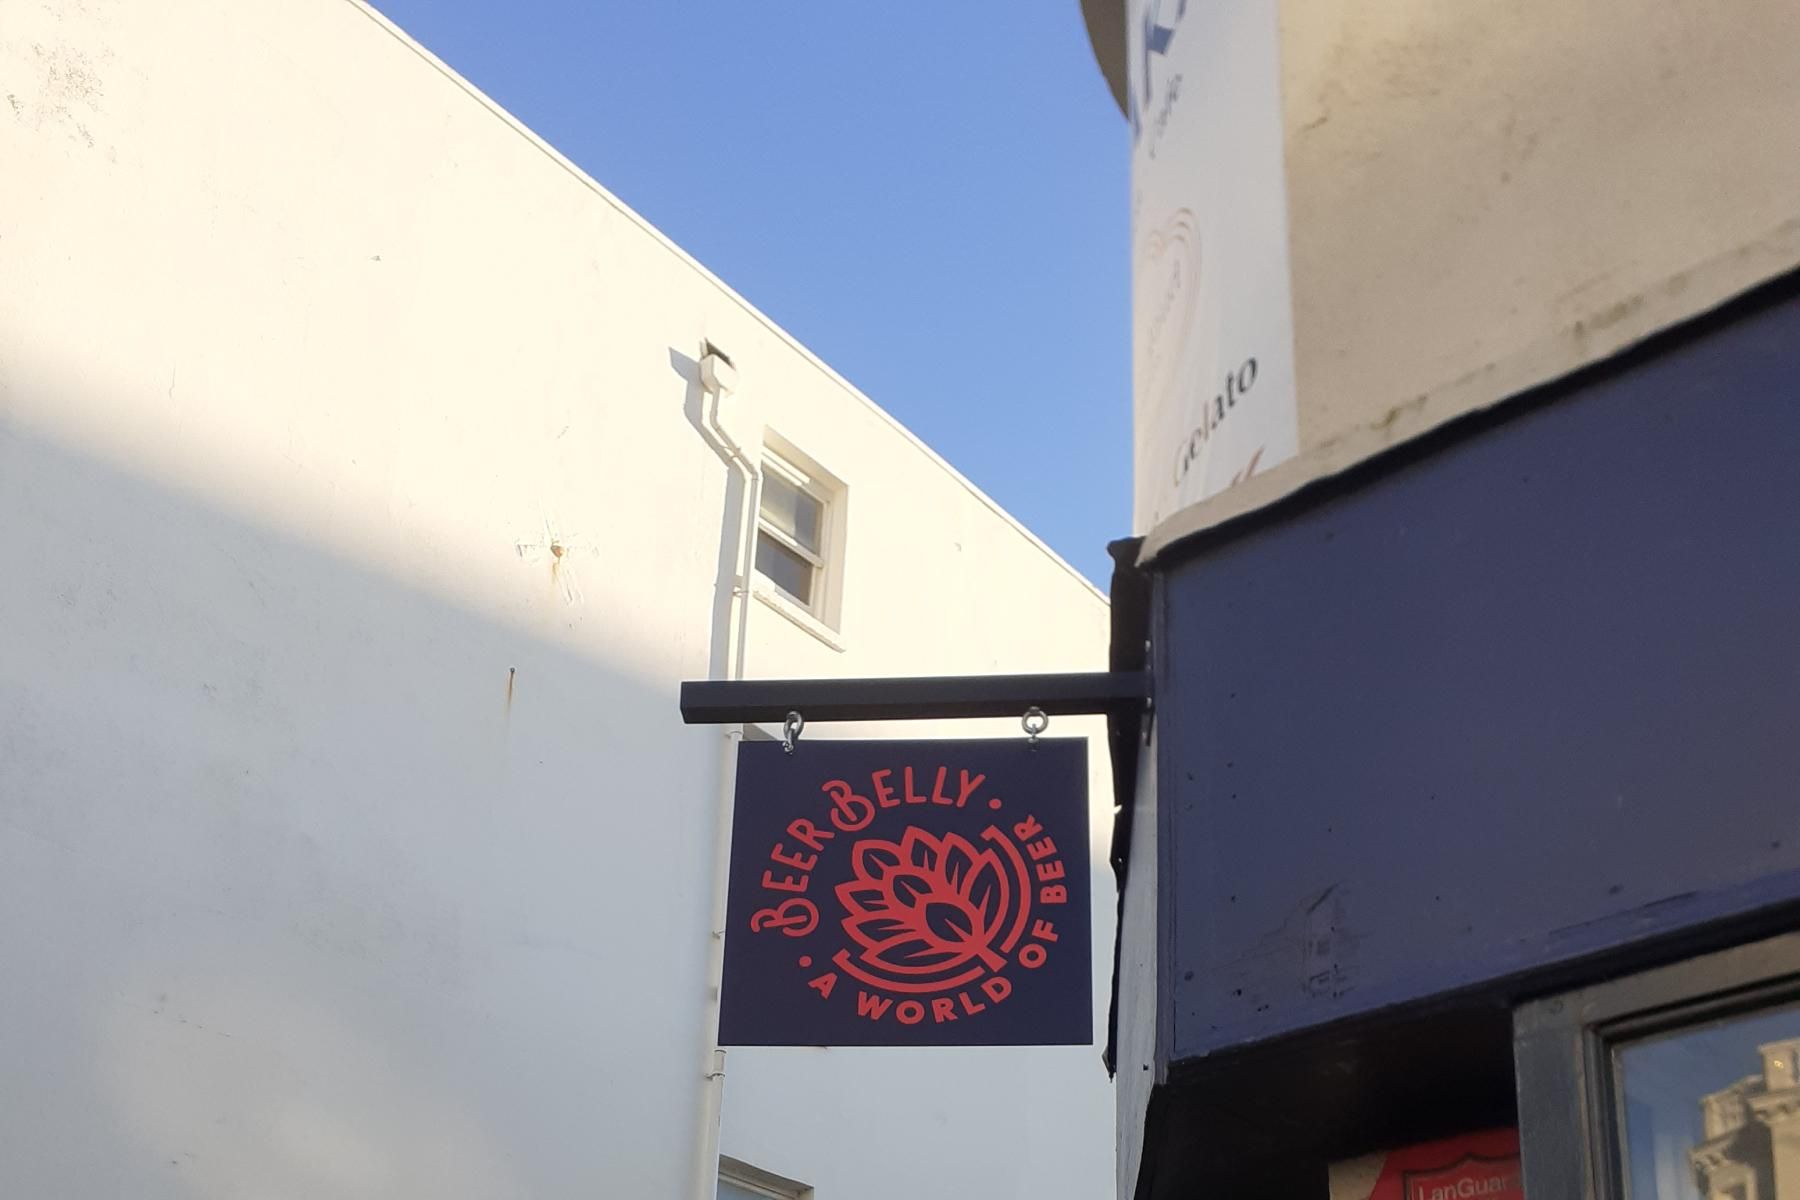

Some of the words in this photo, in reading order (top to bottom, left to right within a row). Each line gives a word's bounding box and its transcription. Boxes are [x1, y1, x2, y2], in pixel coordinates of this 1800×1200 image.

[751, 818, 835, 937] BEER
[822, 766, 986, 832] BELLY
[1013, 814, 1067, 904] BEER
[1019, 919, 1060, 969] OF
[808, 972, 838, 999] A
[857, 976, 1012, 1025] WORLD
